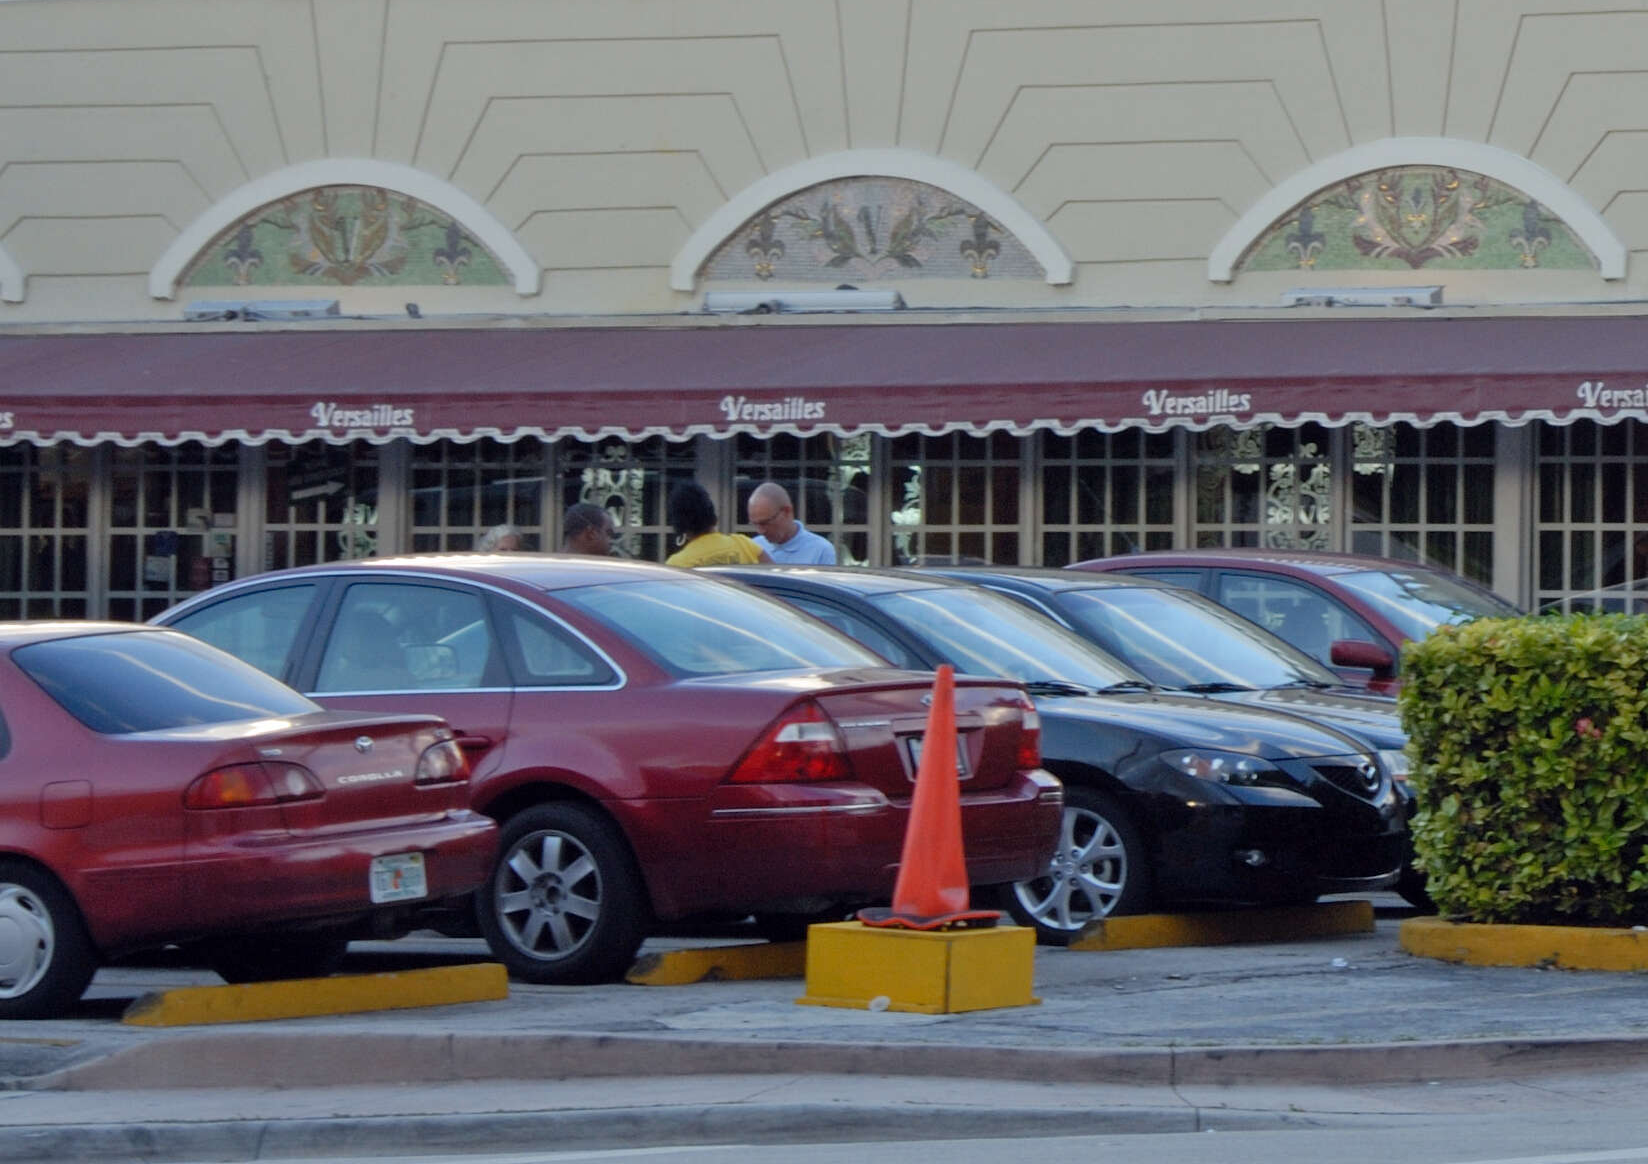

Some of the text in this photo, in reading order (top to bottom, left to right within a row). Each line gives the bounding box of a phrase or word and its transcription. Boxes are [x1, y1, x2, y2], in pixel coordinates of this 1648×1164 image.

[311, 401, 414, 427] Versailles
[720, 395, 825, 421] Versailles
[1143, 389, 1252, 415] Versailles
[337, 769, 403, 784] COROLLA
